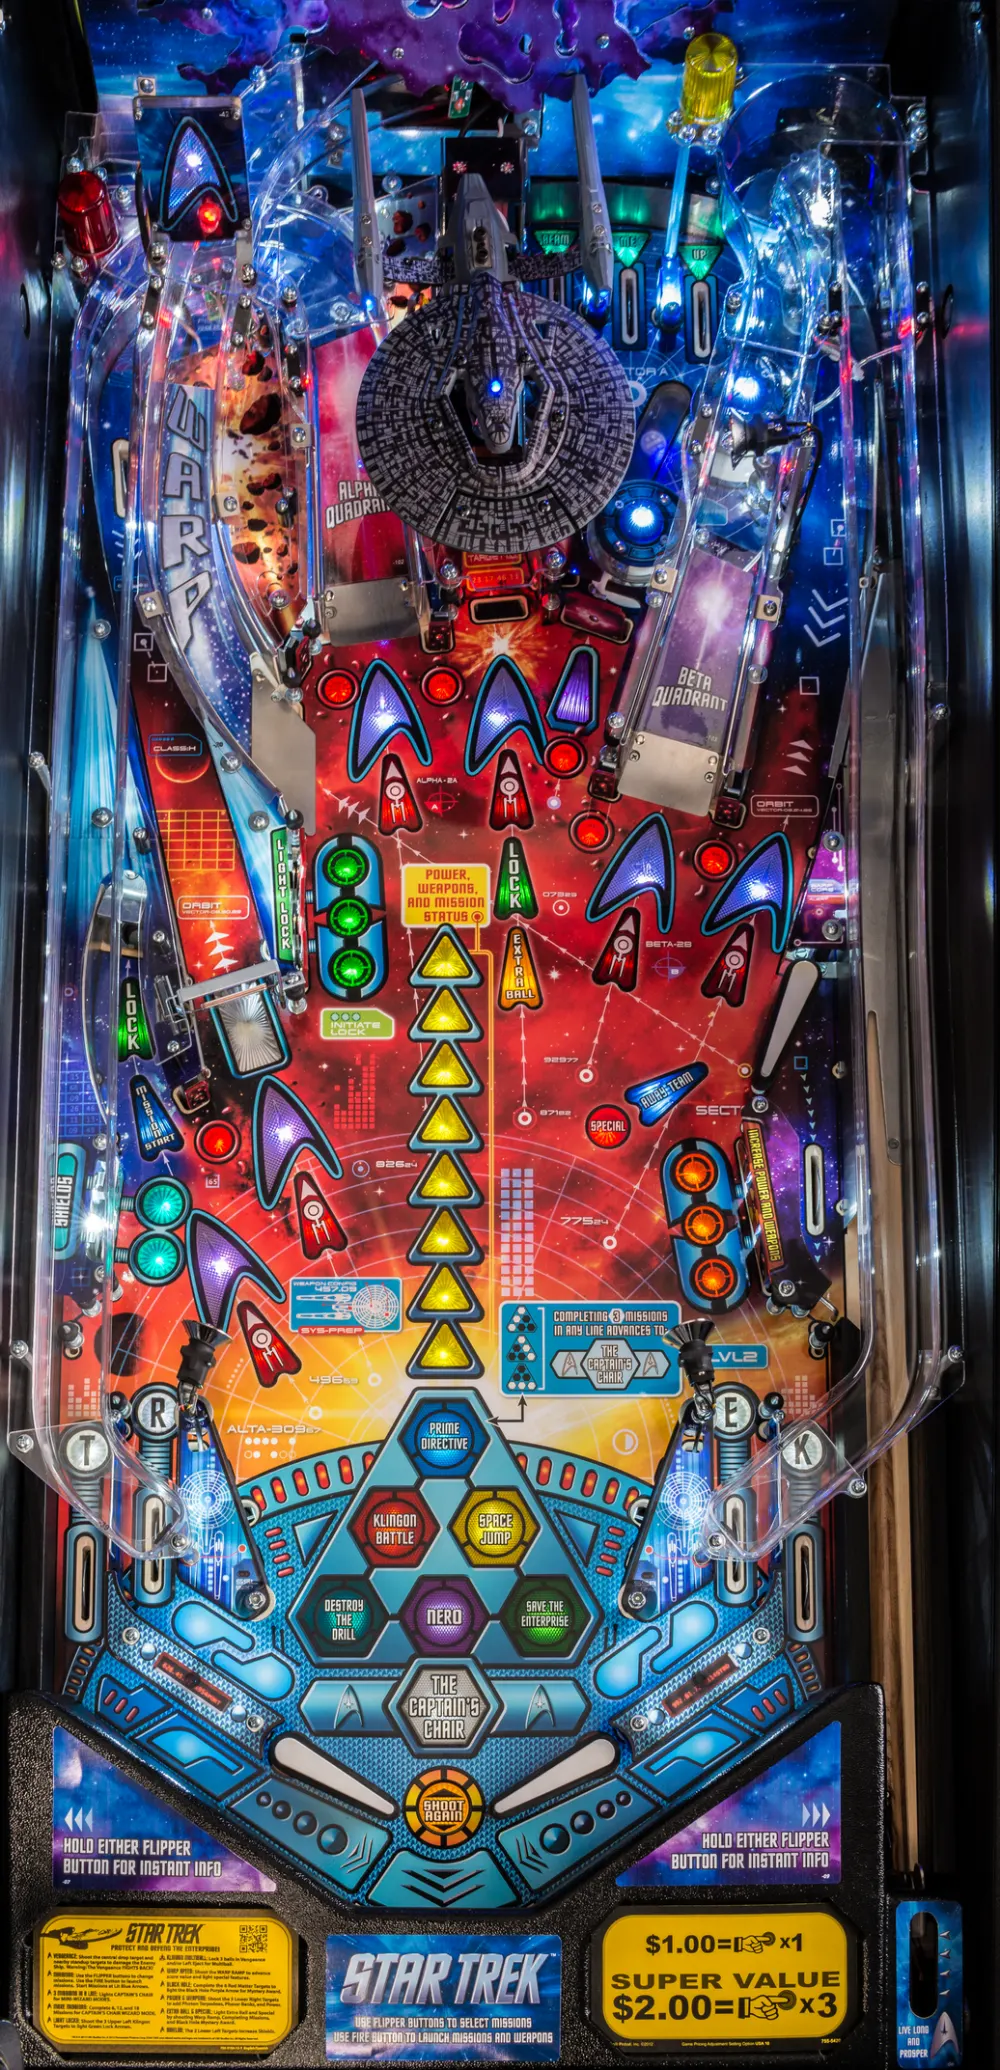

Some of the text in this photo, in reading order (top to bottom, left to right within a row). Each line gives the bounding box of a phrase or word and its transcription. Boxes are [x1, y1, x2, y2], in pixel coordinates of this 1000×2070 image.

[542, 234, 569, 245] BEAM
[692, 249, 706, 260] UP
[162, 386, 212, 650] WARP
[678, 666, 712, 691] BETA
[652, 686, 728, 711] QUADRANT
[426, 869, 470, 881] POWER,
[509, 843, 521, 908] LOCK
[277, 840, 291, 950] LIGHT LOCK
[418, 884, 478, 895] WEAPONS,
[408, 898, 484, 908] AND MISSION
[424, 911, 468, 922] STATUS
[513, 934, 524, 987] EXTRA
[506, 990, 535, 999] BALL
[126, 983, 140, 1050] LOCK
[640, 1071, 694, 1109] AWAY TEAM
[136, 1085, 160, 1138] MISSION
[591, 1120, 626, 1132] SPECIAL
[145, 1133, 175, 1151] START
[55, 1177, 73, 1227] SHIELDS
[747, 1128, 780, 1262] INCREASE POWER AND WEAPONS
[553, 1311, 668, 1322] COMPLETING 3 MISSIONS
[554, 1326, 563, 1336] IN
[565, 1326, 582, 1336] ANY
[585, 1326, 604, 1336] LINE
[606, 1326, 651, 1336] ADVANCES
[601, 1345, 618, 1357] THE
[587, 1358, 632, 1370] CAPTAIN'S
[596, 1372, 623, 1384] CHAIR
[151, 1397, 166, 1428] R
[725, 1397, 737, 1427] E
[429, 1422, 460, 1435] PRIME
[79, 1435, 95, 1466] T
[421, 1438, 468, 1450] DIRECTIVE
[794, 1434, 812, 1465] K
[373, 1514, 417, 1528] KLINGON
[479, 1514, 512, 1528] SPACE
[376, 1531, 414, 1544] BATTLE
[480, 1531, 511, 1545] JUMP
[324, 1600, 363, 1612] DESTROY
[526, 1601, 564, 1612] SAVE THE
[336, 1614, 352, 1626] THE
[427, 1609, 462, 1625] NERO
[521, 1615, 569, 1627] ENTERPRISE
[332, 1628, 356, 1640] DRILL
[431, 1675, 457, 1694] THE
[408, 1698, 480, 1717] CAPTAIN'S
[423, 1719, 465, 1739] CHAIR
[423, 1800, 465, 1811] SHOOT
[425, 1811, 463, 1821] AGAIN
[64, 1838, 190, 1856] HOLD EITHER FLIPPER
[702, 1832, 829, 1848] HOLD EITHER FLIPPER
[64, 1858, 222, 1877] BUTTON FOR INSTANT INFO
[672, 1852, 829, 1869] BUTTON FOR INSTANT INFO
[126, 1923, 206, 1944] STAR TREK
[646, 1933, 802, 1955] $1.00= x1
[340, 1953, 549, 2004] STAR TREK
[611, 1971, 841, 1990] SUPER VALUE
[612, 1992, 837, 2024] $2.00= x3
[355, 2017, 532, 2028] USE FLIPPER BUTTONS TO SELECT MISSIONS
[898, 2026, 929, 2034] LIVE LONG
[334, 2032, 553, 2043] USE FIRE BUTTON TO LAUNCH MISSIONS AND WEAPONS
[908, 2038, 920, 2046] AND
[900, 2049, 928, 2058] PROSPER
